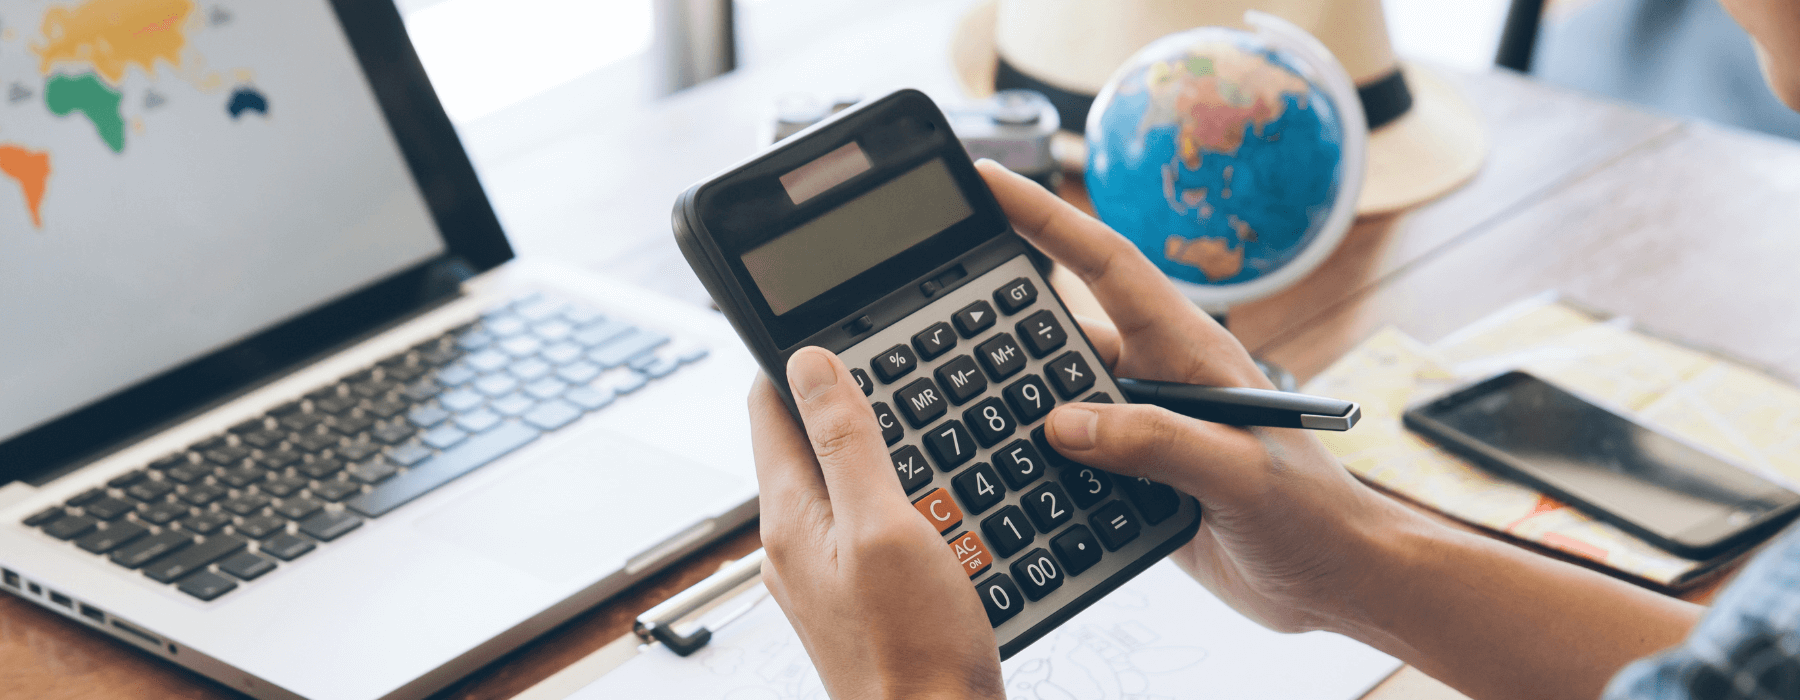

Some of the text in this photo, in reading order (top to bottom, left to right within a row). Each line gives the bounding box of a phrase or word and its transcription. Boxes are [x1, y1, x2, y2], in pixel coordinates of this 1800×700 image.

[1010, 284, 1028, 300] GT
[991, 344, 1016, 366] M+
[950, 367, 976, 388] M-
[910, 388, 939, 411] MR
[1022, 383, 1041, 409] 9
[982, 405, 1006, 432] 8
[940, 427, 961, 456] 7
[1010, 447, 1034, 475] 5
[975, 471, 995, 496] 4
[1080, 469, 1102, 494] 3
[930, 499, 951, 522] C
[1040, 491, 1065, 519] 2
[1002, 515, 1023, 540] 1
[954, 536, 977, 559] AC
[969, 558, 983, 569] ON
[1027, 556, 1057, 586] 00
[989, 584, 1011, 610] 0
